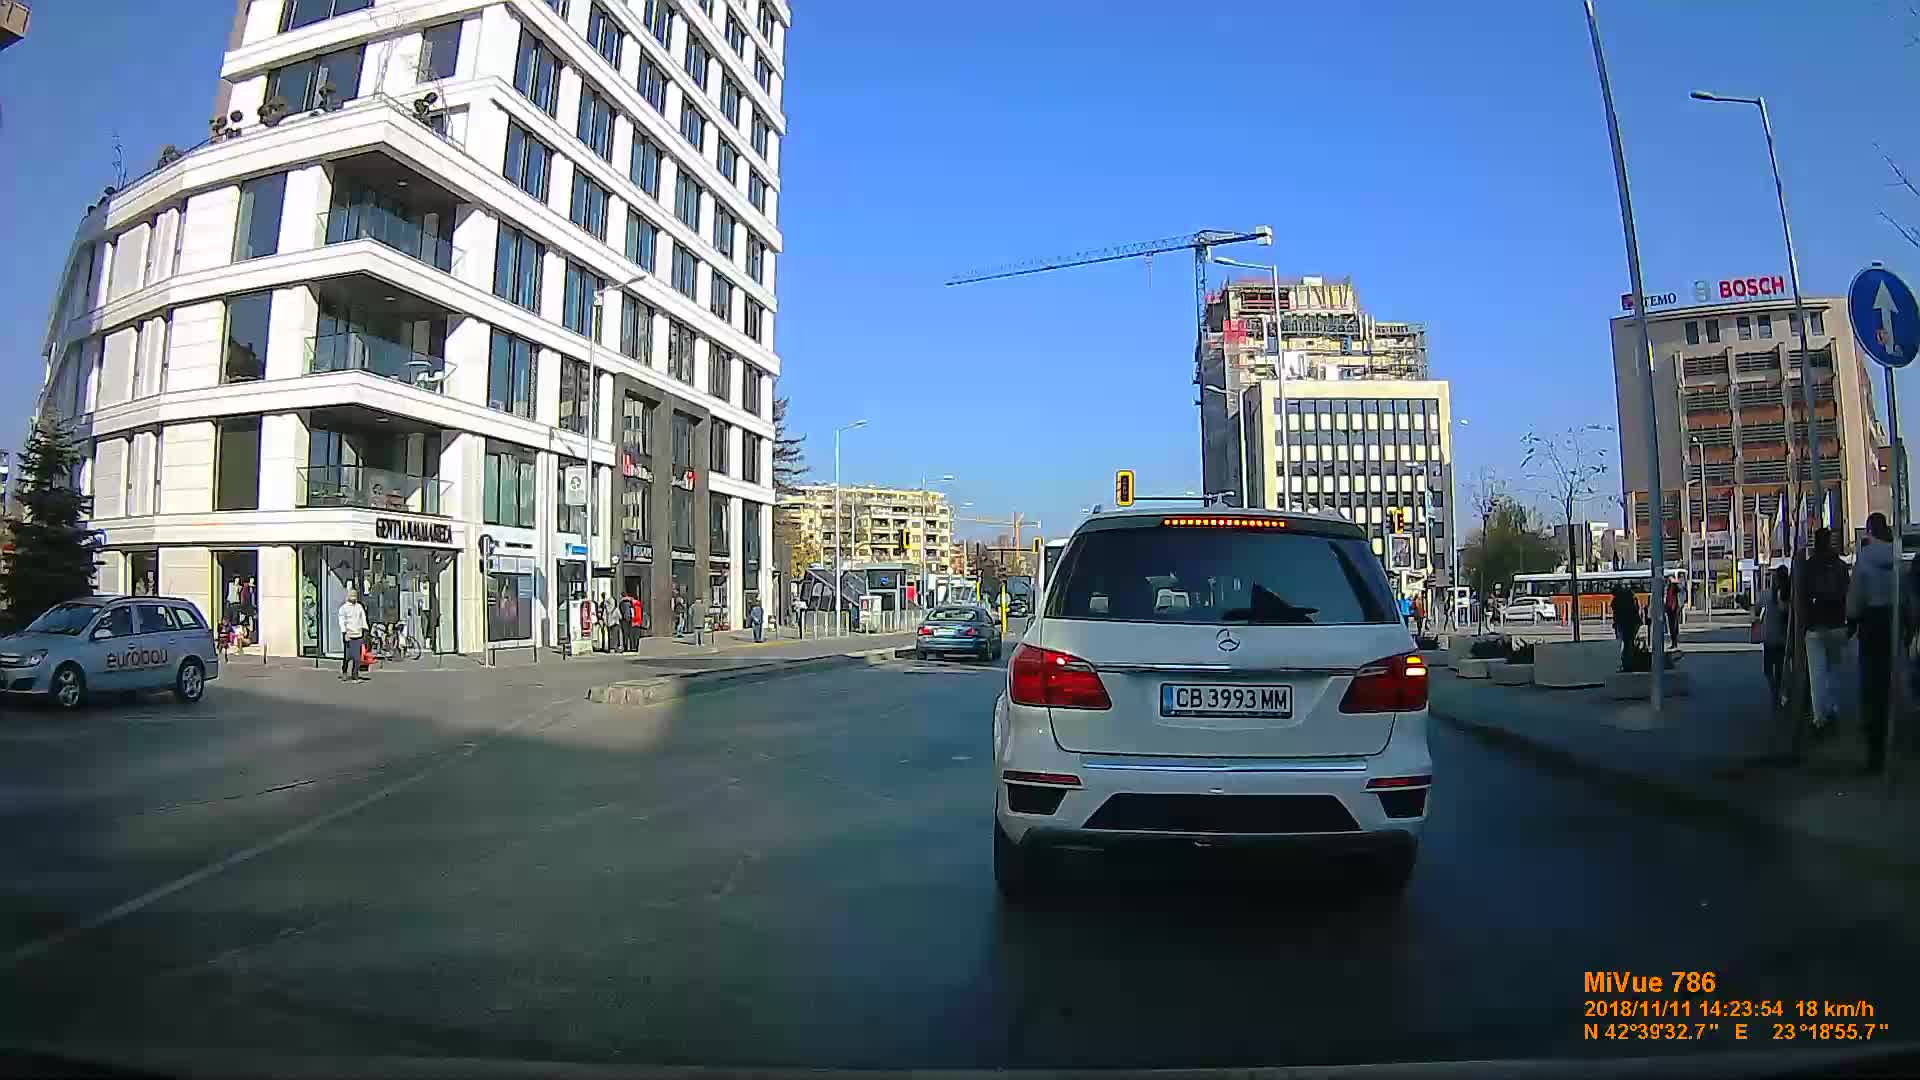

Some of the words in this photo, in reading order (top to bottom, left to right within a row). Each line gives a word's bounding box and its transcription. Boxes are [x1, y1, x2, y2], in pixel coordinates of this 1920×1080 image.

[1719, 276, 1784, 298] BOSCH
[1643, 292, 1677, 308] TEMO
[1176, 687, 1203, 708] CB
[1207, 688, 1257, 709] 3993
[1261, 689, 1287, 710] MM
